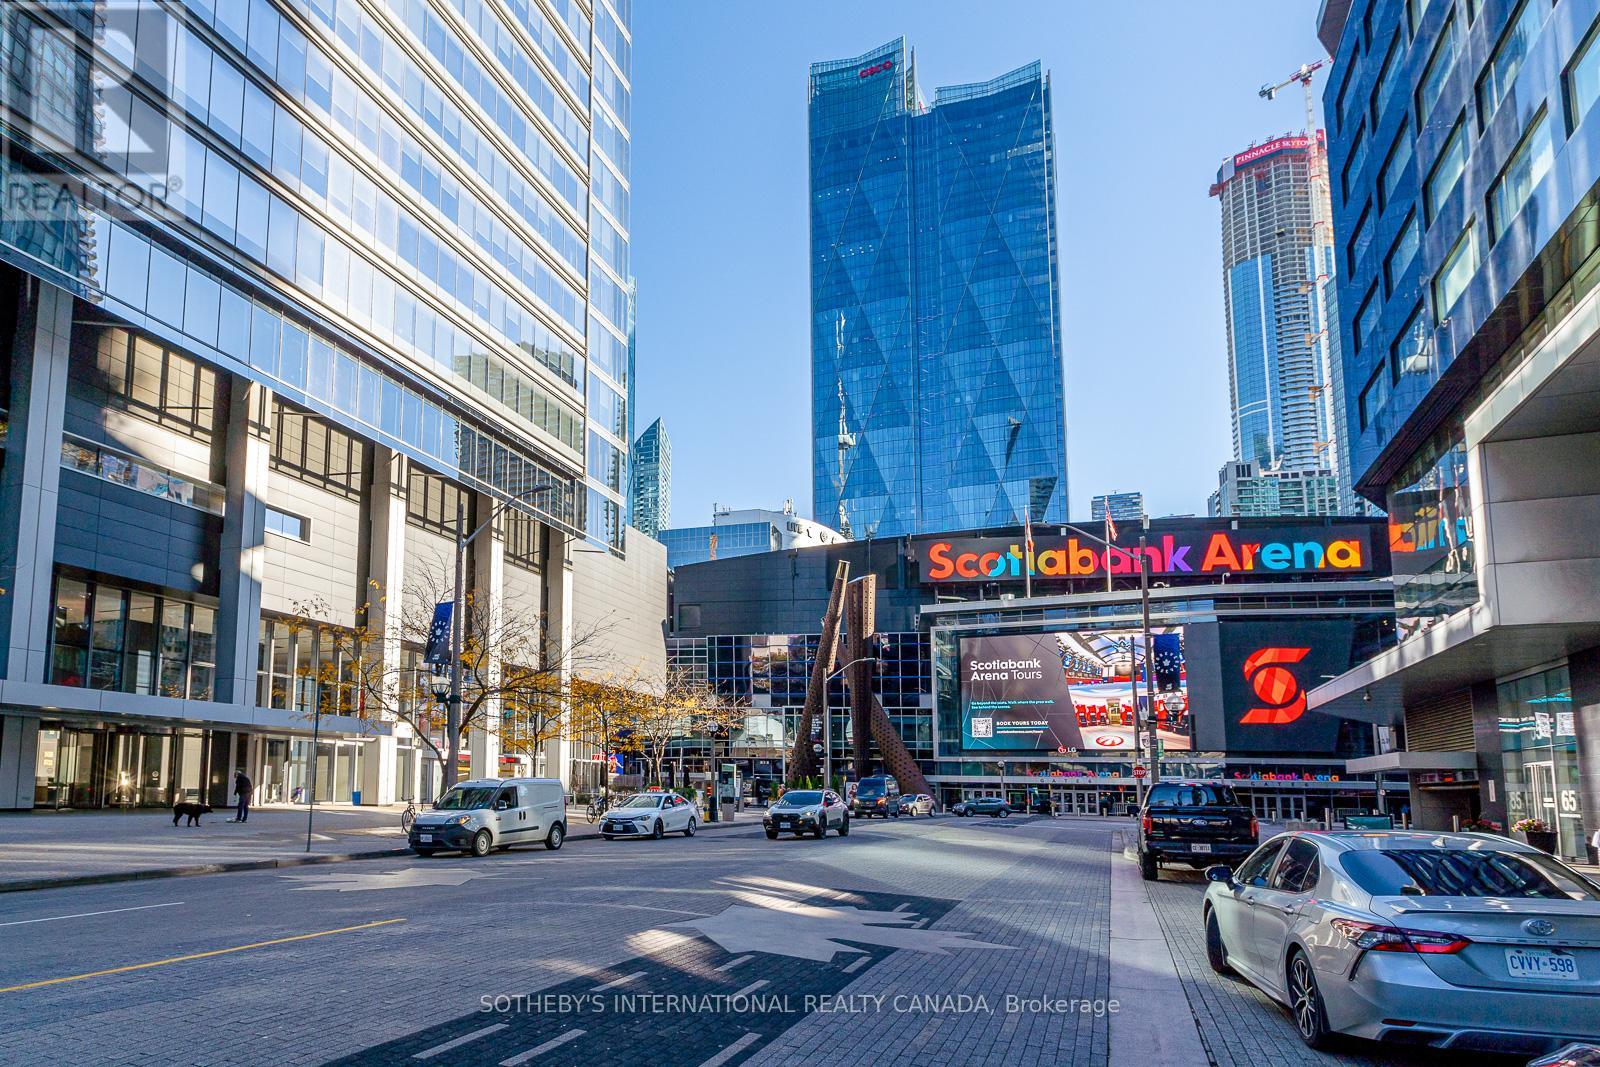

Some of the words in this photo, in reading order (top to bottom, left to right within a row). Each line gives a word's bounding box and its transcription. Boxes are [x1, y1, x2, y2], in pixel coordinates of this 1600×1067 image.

[1236, 142, 1281, 164] PINNACLE
[928, 535, 1193, 579] Scotiabank
[1202, 533, 1362, 571] Arena
[970, 658, 1041, 671] Scotiabank
[971, 671, 1008, 681] Arena
[1010, 669, 1042, 680] Tours
[1233, 771, 1299, 781] Scotiabank
[1302, 773, 1340, 782] Arena
[1561, 790, 1577, 811] 65
[1510, 956, 1541, 971] CVVY
[1549, 958, 1574, 973] 598
